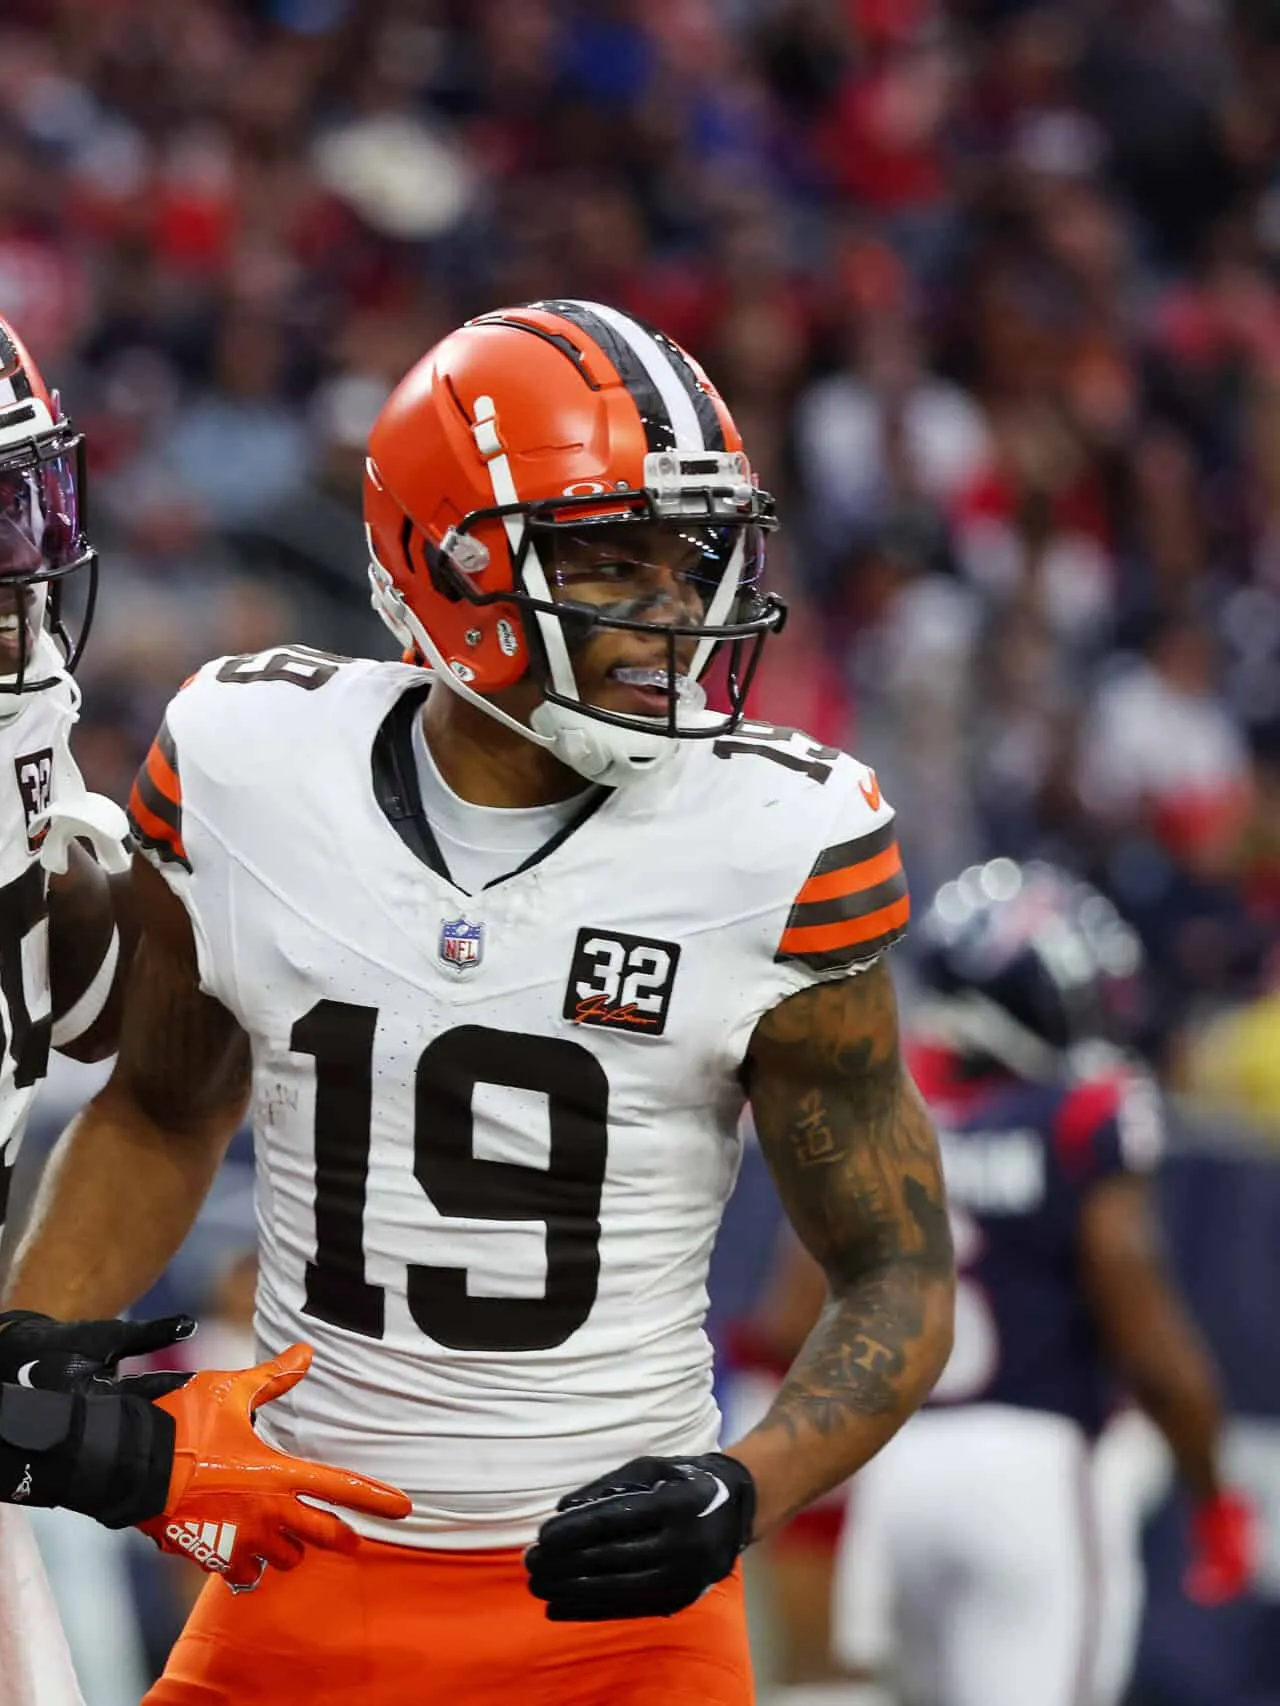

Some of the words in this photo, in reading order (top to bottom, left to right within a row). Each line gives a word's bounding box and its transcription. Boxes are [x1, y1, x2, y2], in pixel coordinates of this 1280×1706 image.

[576, 938, 671, 1013] 32
[289, 998, 609, 1353] 19
[166, 1524, 231, 1572] adidas
